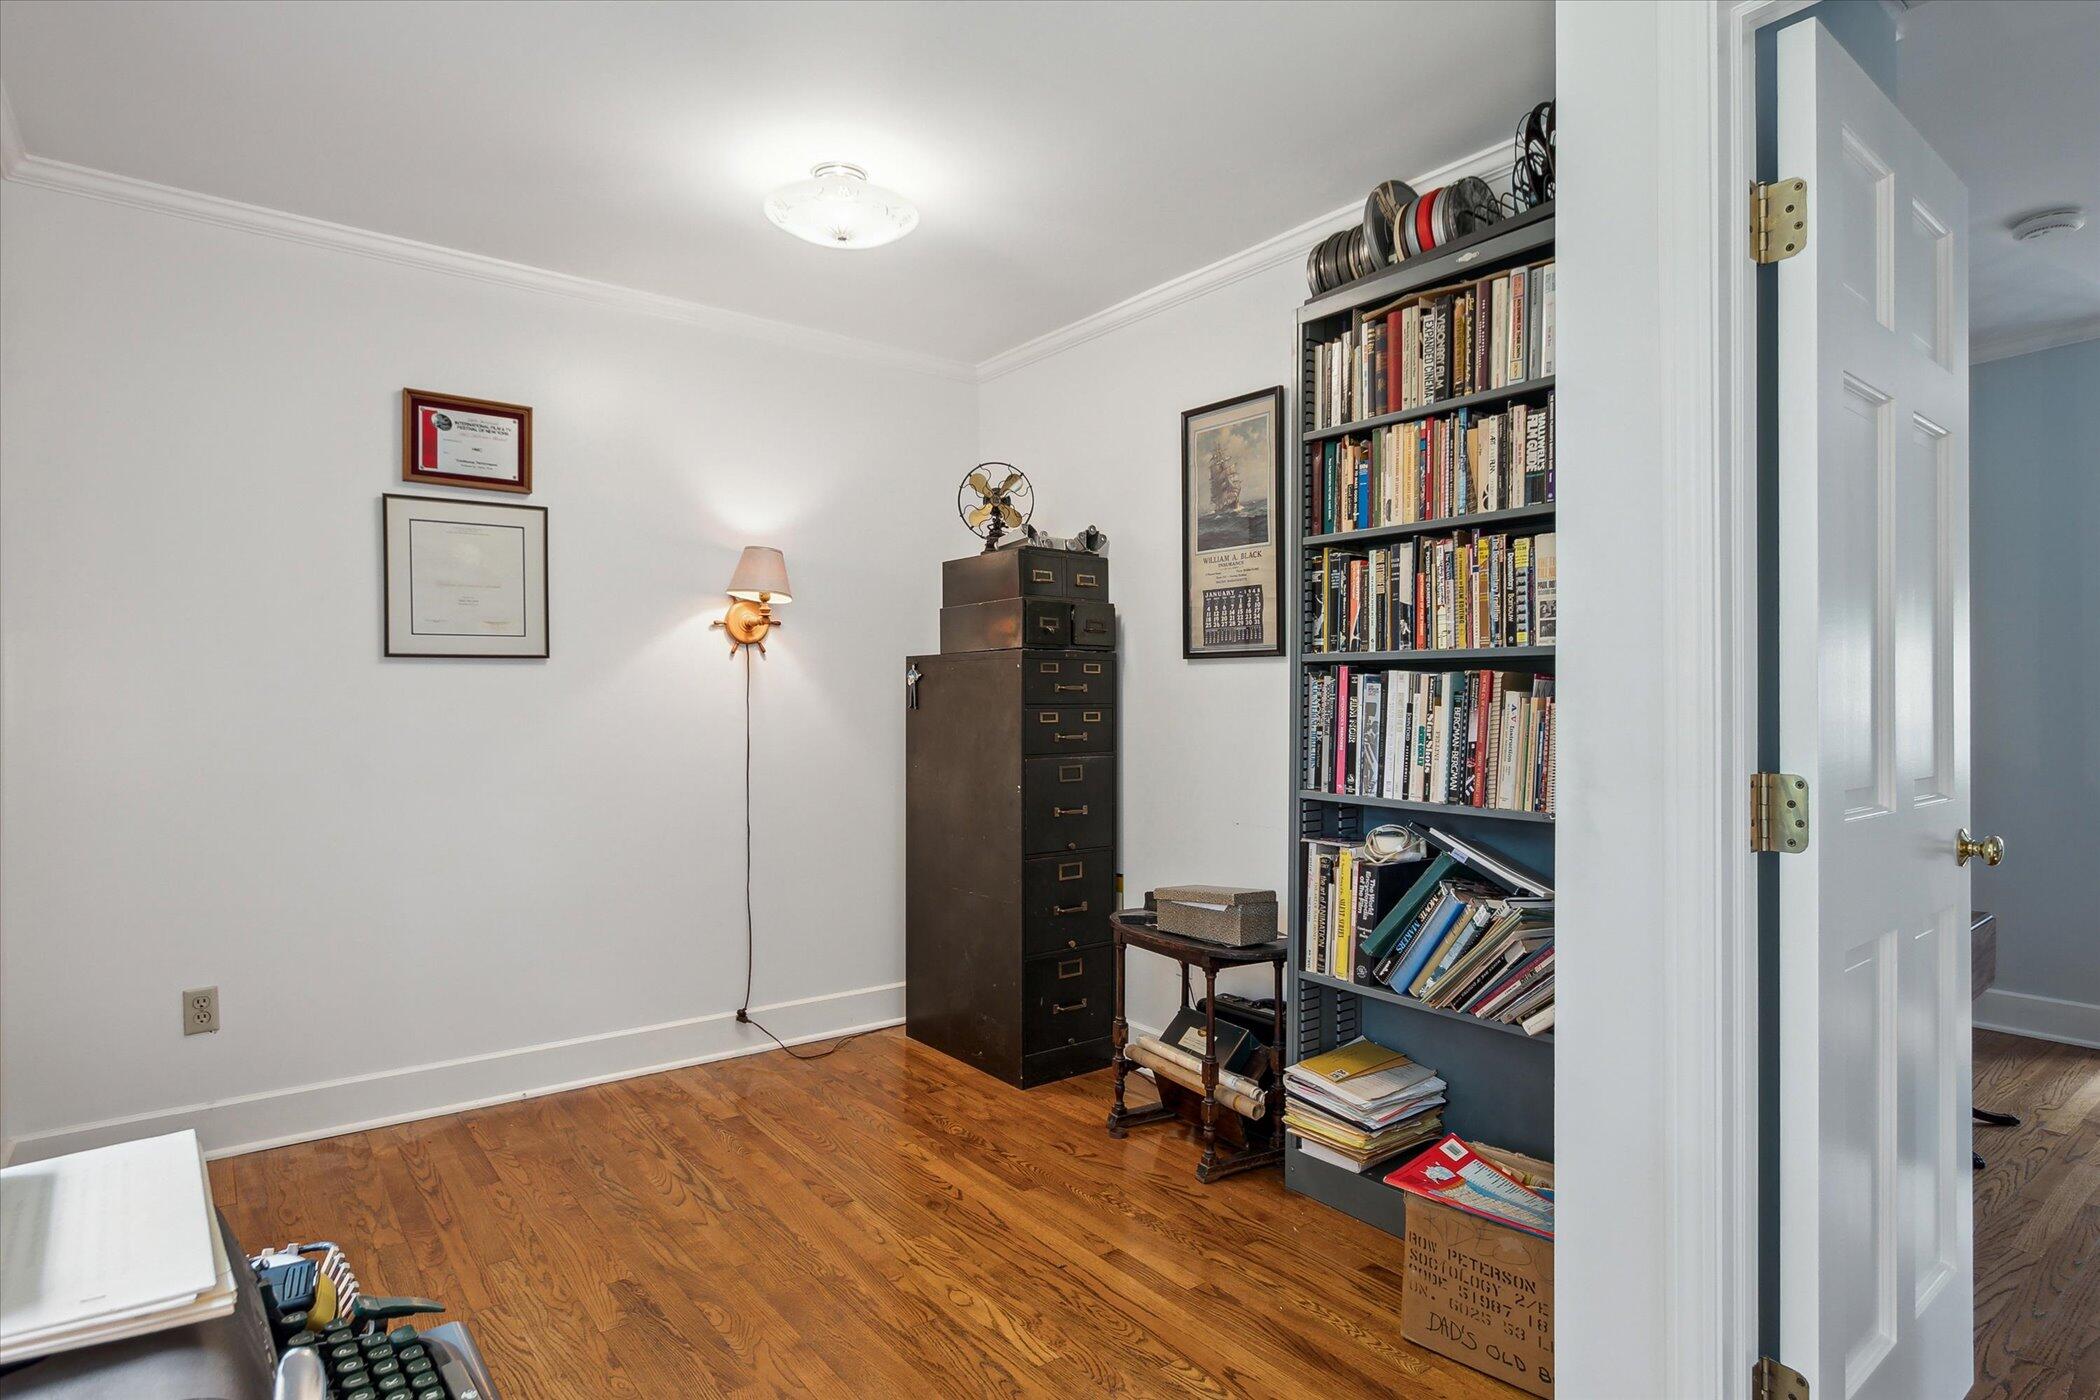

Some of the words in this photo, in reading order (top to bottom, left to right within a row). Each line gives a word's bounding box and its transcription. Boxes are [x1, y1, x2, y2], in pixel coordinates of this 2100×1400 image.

[1424, 321, 1434, 365] EXPANDED
[1436, 313, 1445, 364] VISIONARY
[1424, 366, 1434, 398] CINEMA
[1436, 366, 1445, 389] FILM
[1527, 414, 1538, 439] FILM
[1537, 413, 1546, 471] HALLIWELL'S
[1526, 440, 1537, 472] GUIDE
[1203, 555, 1229, 564] WILLIAM
[1241, 551, 1262, 560] BLACK
[1491, 551, 1499, 592] Documentary
[1205, 590, 1234, 598] JANUARY
[1349, 696, 1358, 718] FILM
[1348, 720, 1357, 743] NOIR
[1426, 714, 1434, 739] Star
[1452, 707, 1462, 747] BERGMAN
[1424, 740, 1432, 774] Shots
[1450, 750, 1459, 790] BERGMAN
[1359, 876, 1364, 884] of
[1362, 871, 1371, 920] Encyclopedia
[1338, 898, 1346, 916] SILENT
[1419, 895, 1438, 922] MOVIE
[1318, 904, 1326, 948] ANIMATION
[1396, 921, 1420, 953] MAKERS
[1409, 1231, 1437, 1253] ROW
[1448, 1249, 1536, 1294] PETERSON
[1410, 1248, 1500, 1297] SOCIOLOGY
[1426, 1311, 1477, 1350] DAD'S
[1486, 1345, 1526, 1372] OLD
[1538, 1366, 1554, 1384] B
